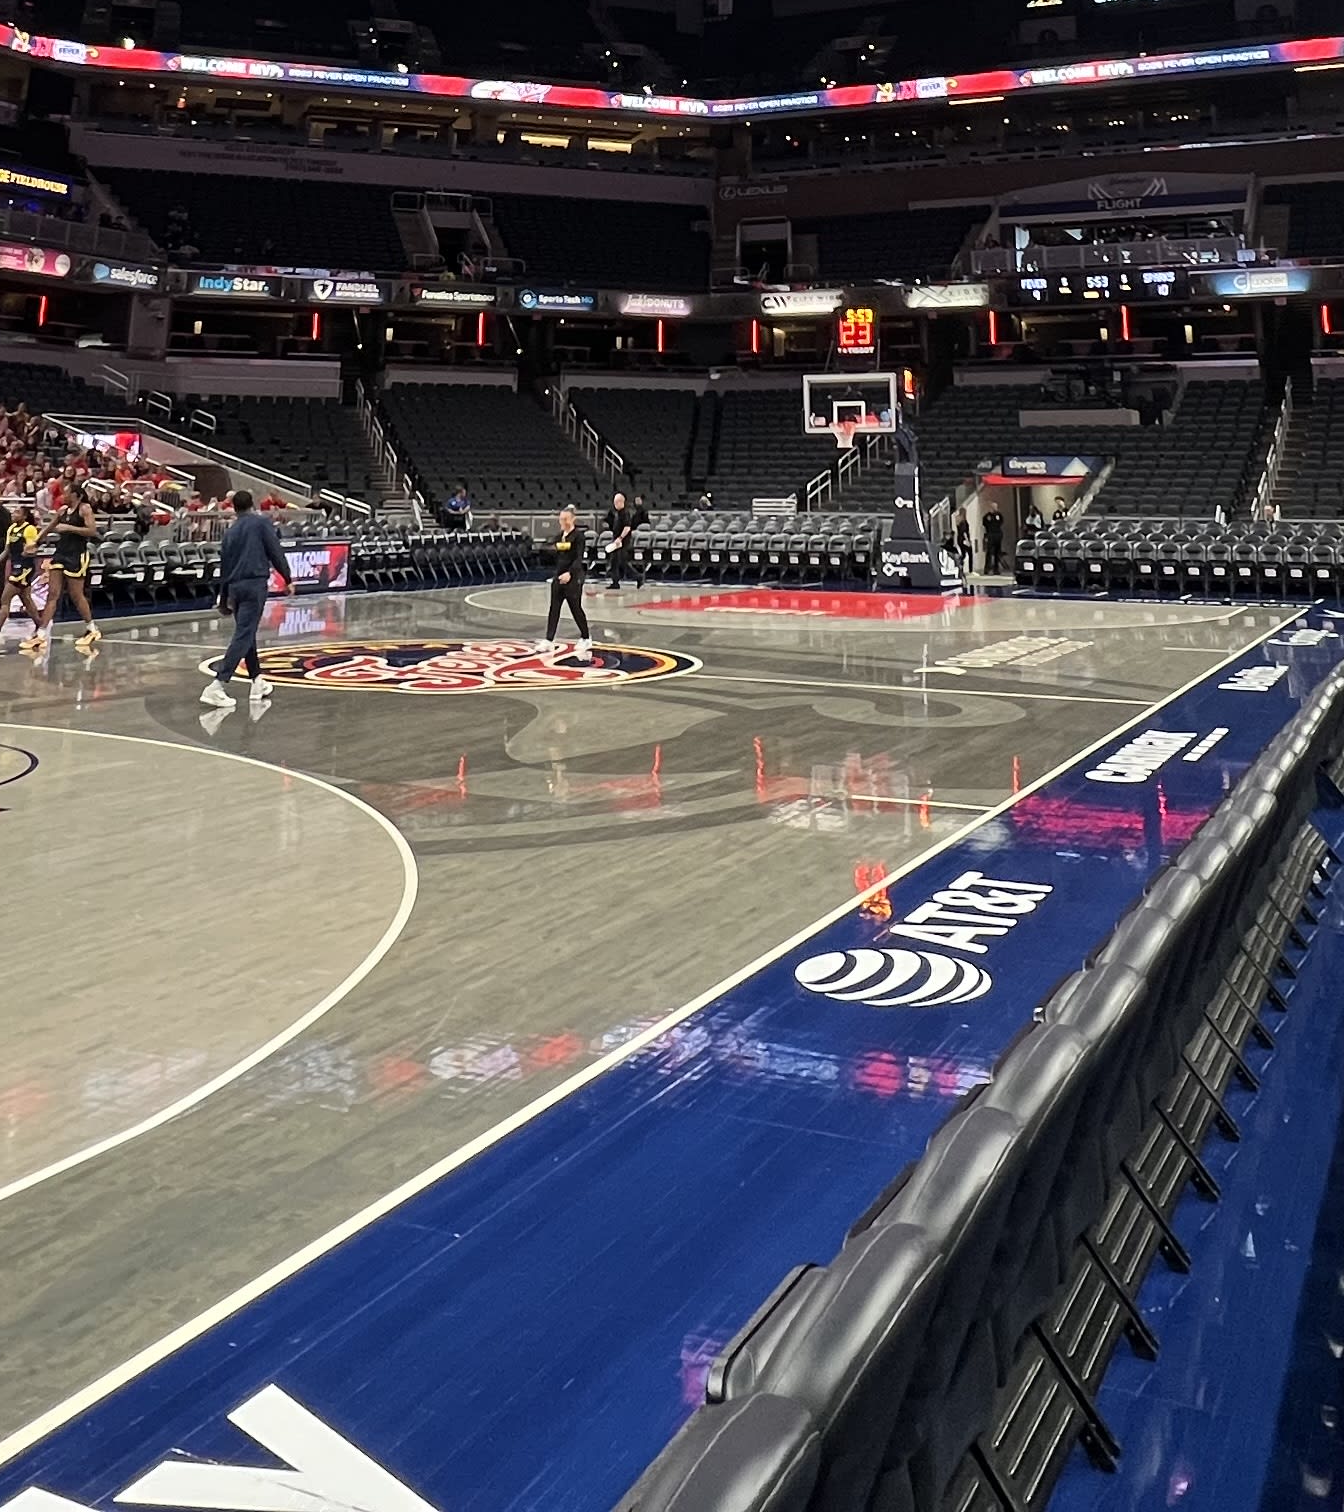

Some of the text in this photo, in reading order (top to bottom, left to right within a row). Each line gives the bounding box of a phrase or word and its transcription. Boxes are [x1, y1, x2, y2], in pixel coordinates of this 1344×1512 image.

[180, 55, 247, 75] WELCOME
[1029, 64, 1096, 86] WELCOME
[1097, 197, 1144, 211] FLIGHT
[110, 266, 159, 287] salesforce
[199, 276, 270, 293] IndyStar.
[840, 322, 871, 346] 23
[880, 550, 930, 564] KeyBank
[889, 870, 1055, 955] AT&T
